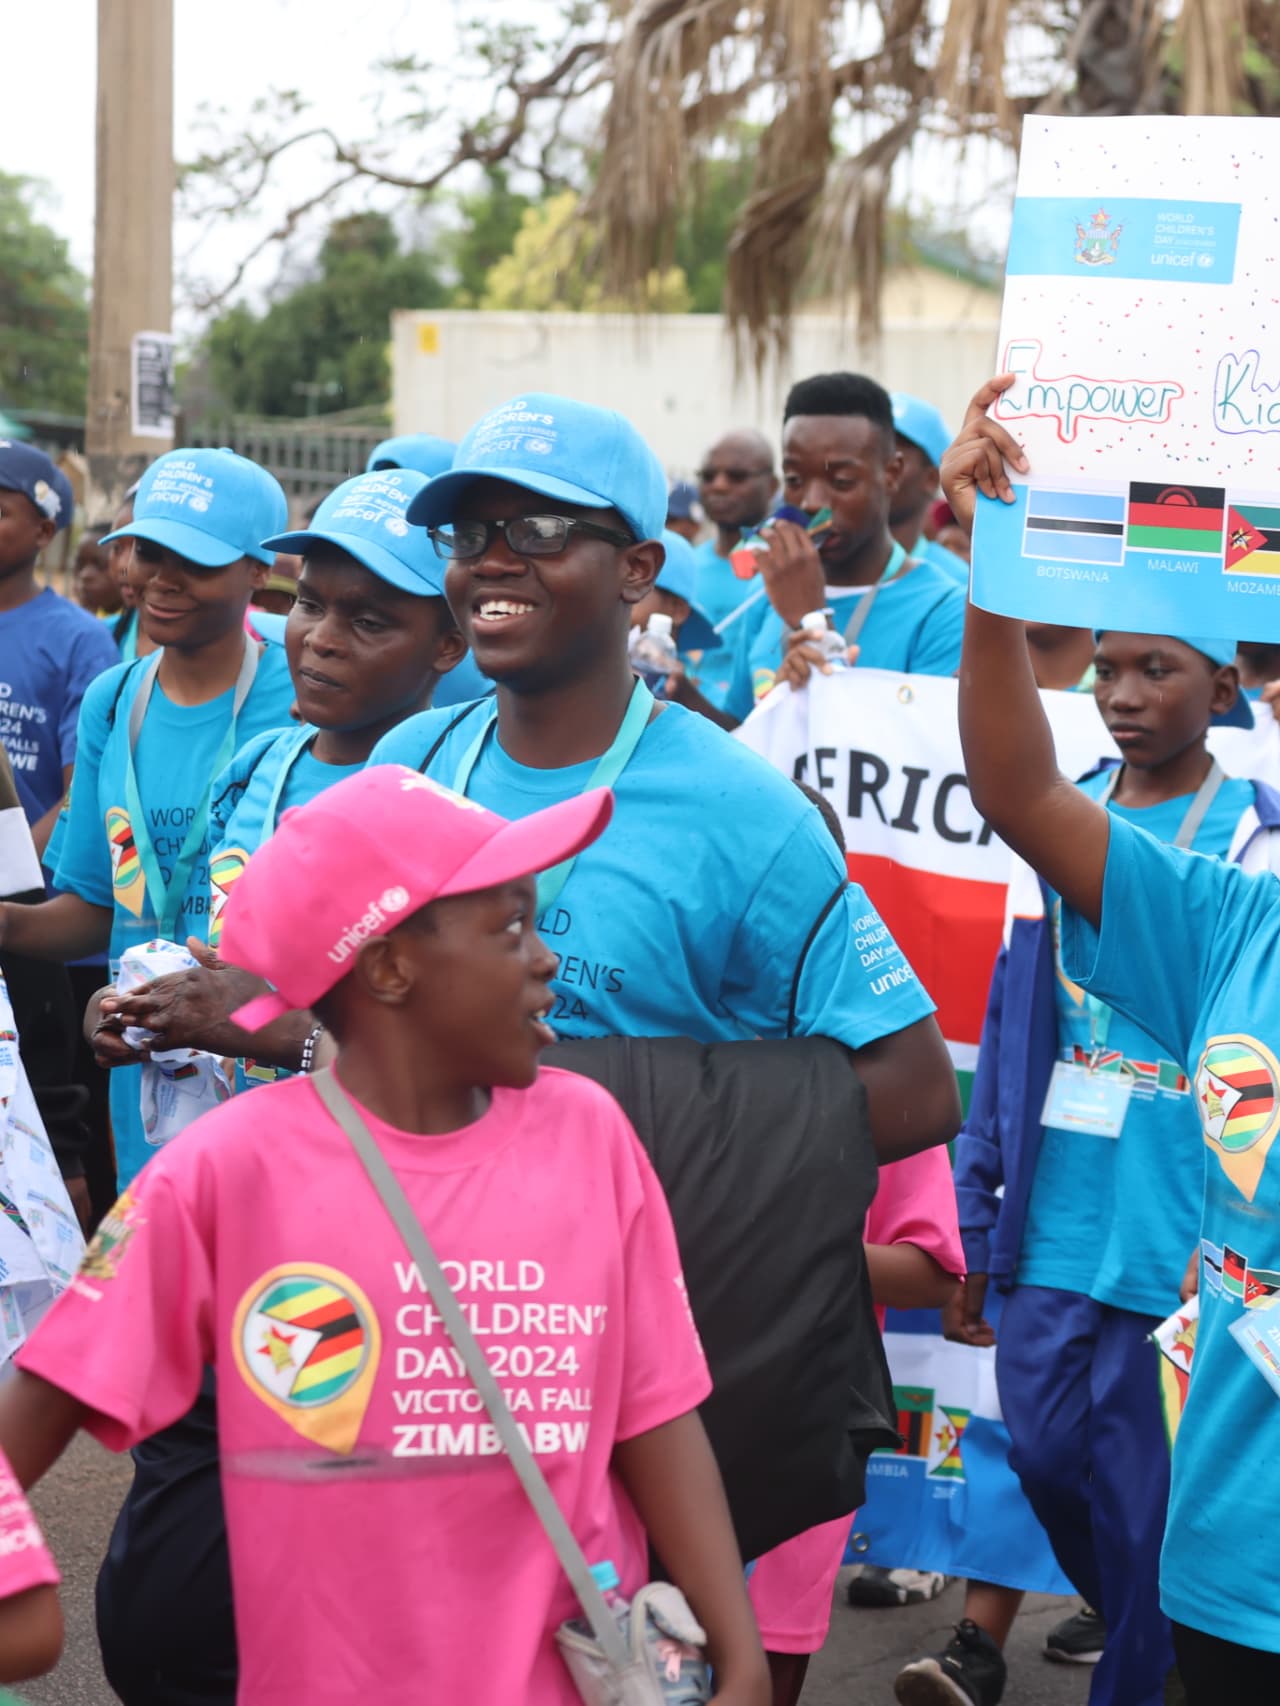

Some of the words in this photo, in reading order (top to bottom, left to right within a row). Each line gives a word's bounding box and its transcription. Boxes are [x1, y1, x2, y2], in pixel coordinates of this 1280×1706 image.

[1151, 249, 1196, 269] unicef
[1001, 346, 1178, 434] Empower
[1036, 565, 1110, 584] BOTSWANA
[1147, 558, 1200, 575] MALAWI
[151, 808, 196, 828] WOR
[327, 902, 387, 963] unicef
[860, 947, 884, 967] DAY
[869, 965, 914, 995] unice
[393, 1260, 545, 1293] WORLD
[396, 1347, 467, 1380] DAY
[486, 1346, 580, 1378] 2024
[392, 1387, 535, 1415] VICTOIA
[541, 1388, 592, 1412] FALL
[392, 1422, 590, 1457] ZIMBABW
